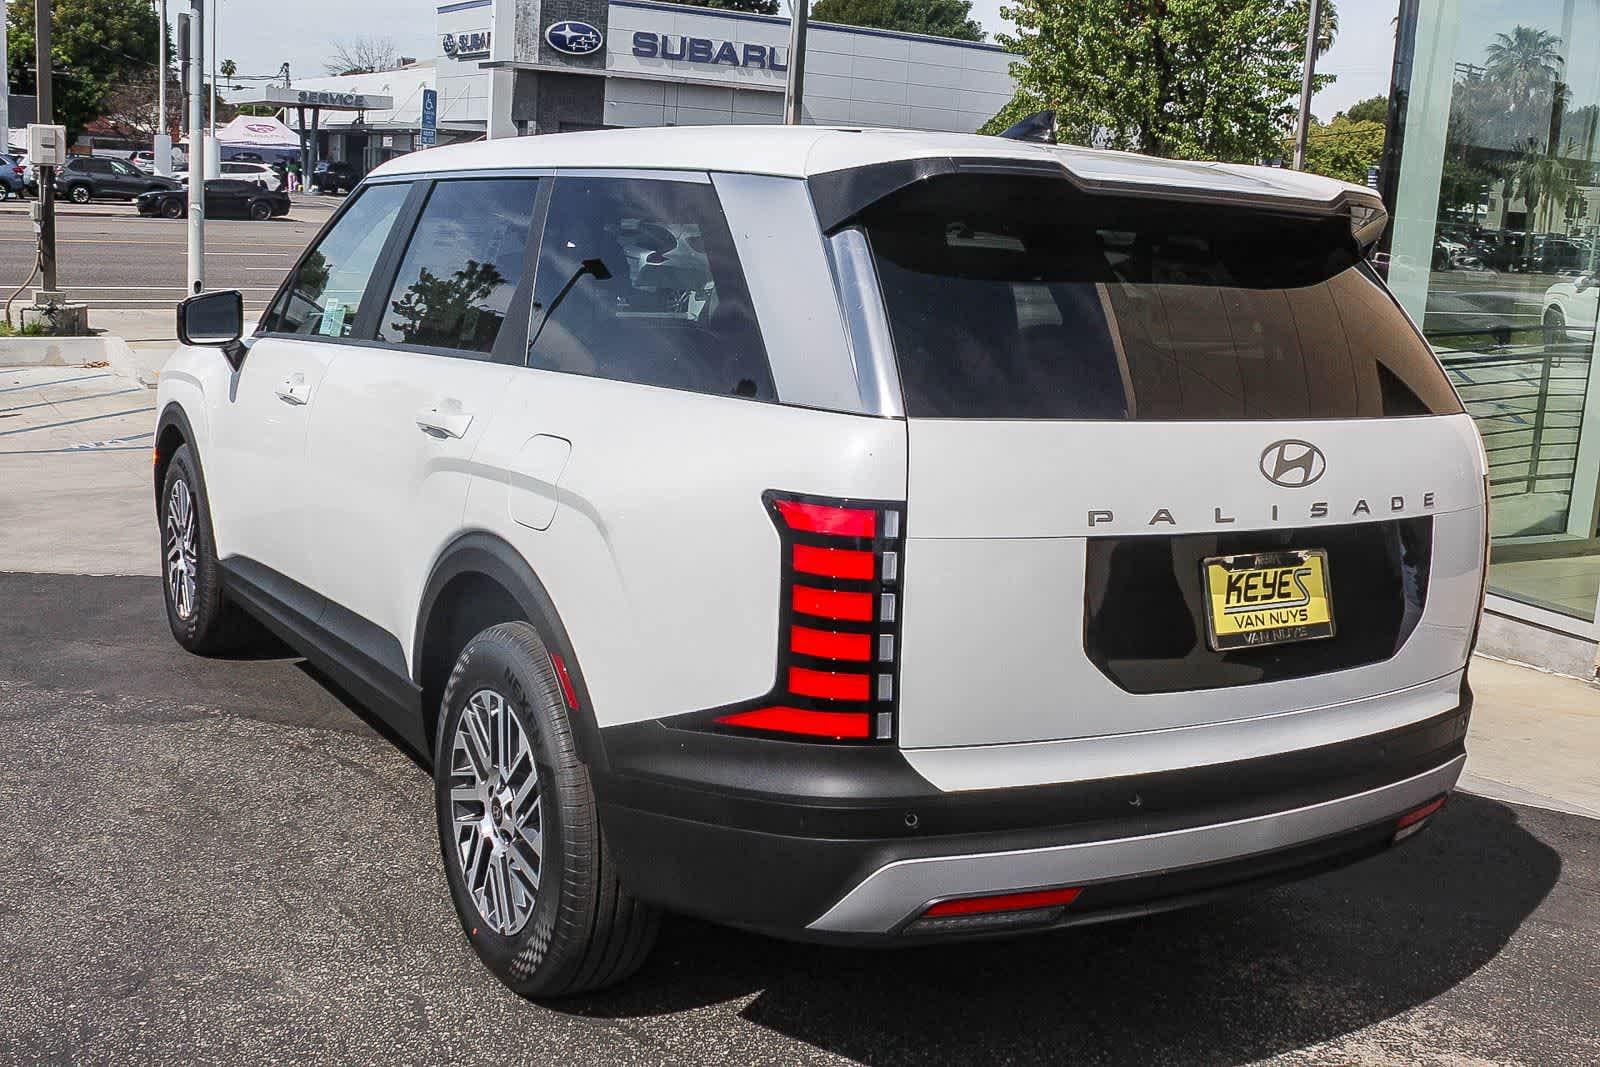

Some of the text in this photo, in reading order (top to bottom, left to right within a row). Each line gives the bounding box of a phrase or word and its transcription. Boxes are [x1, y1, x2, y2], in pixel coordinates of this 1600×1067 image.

[298, 91, 365, 106] SERVICE
[1088, 492, 1435, 527] PALISADE
[1225, 568, 1312, 607] KEYES
[1234, 609, 1309, 629] VAN NUYS
